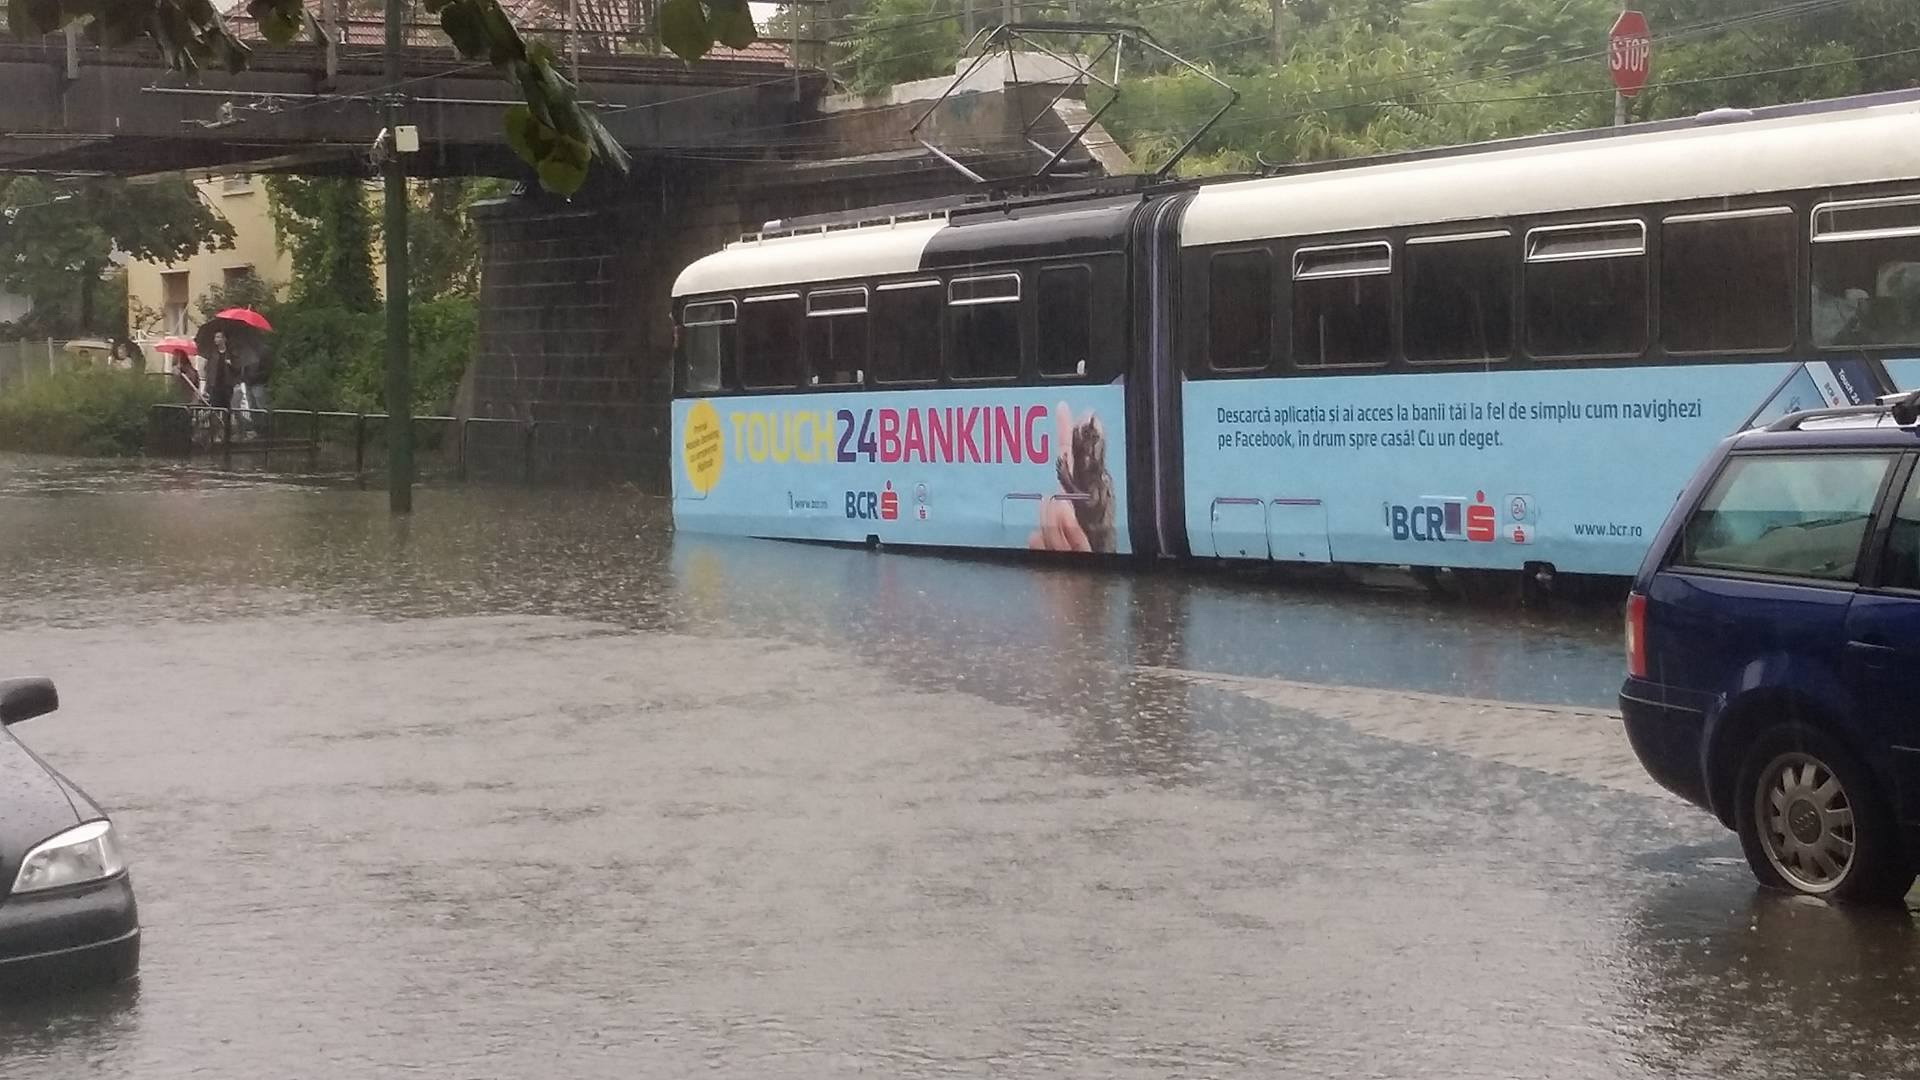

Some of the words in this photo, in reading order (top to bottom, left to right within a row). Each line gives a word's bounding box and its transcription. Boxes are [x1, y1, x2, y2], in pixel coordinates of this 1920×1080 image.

[1611, 37, 1649, 72] STOP
[1839, 368, 1854, 394] Touch
[1217, 406, 1271, 424] Descarcă
[1343, 405, 1354, 422] ai
[1357, 407, 1394, 422] acces
[1397, 403, 1409, 421] la
[1412, 403, 1445, 421] banii
[1471, 402, 1483, 420] la
[1487, 402, 1505, 420] fel
[1509, 402, 1527, 420] de
[1530, 401, 1581, 423] simplu
[1585, 403, 1618, 419] cum
[1622, 398, 1702, 422] navighezi
[1218, 433, 1232, 450] pe
[1235, 430, 1295, 448] Facebook,
[1313, 430, 1346, 447] drum
[1349, 431, 1378, 450] spre
[1418, 429, 1435, 447] Cu
[1438, 432, 1455, 447] un
[1459, 428, 1504, 450] deget.
[845, 490, 878, 520] BCR
[1391, 504, 1446, 542] BCR
[1574, 522, 1643, 537] www.bcr.ro
